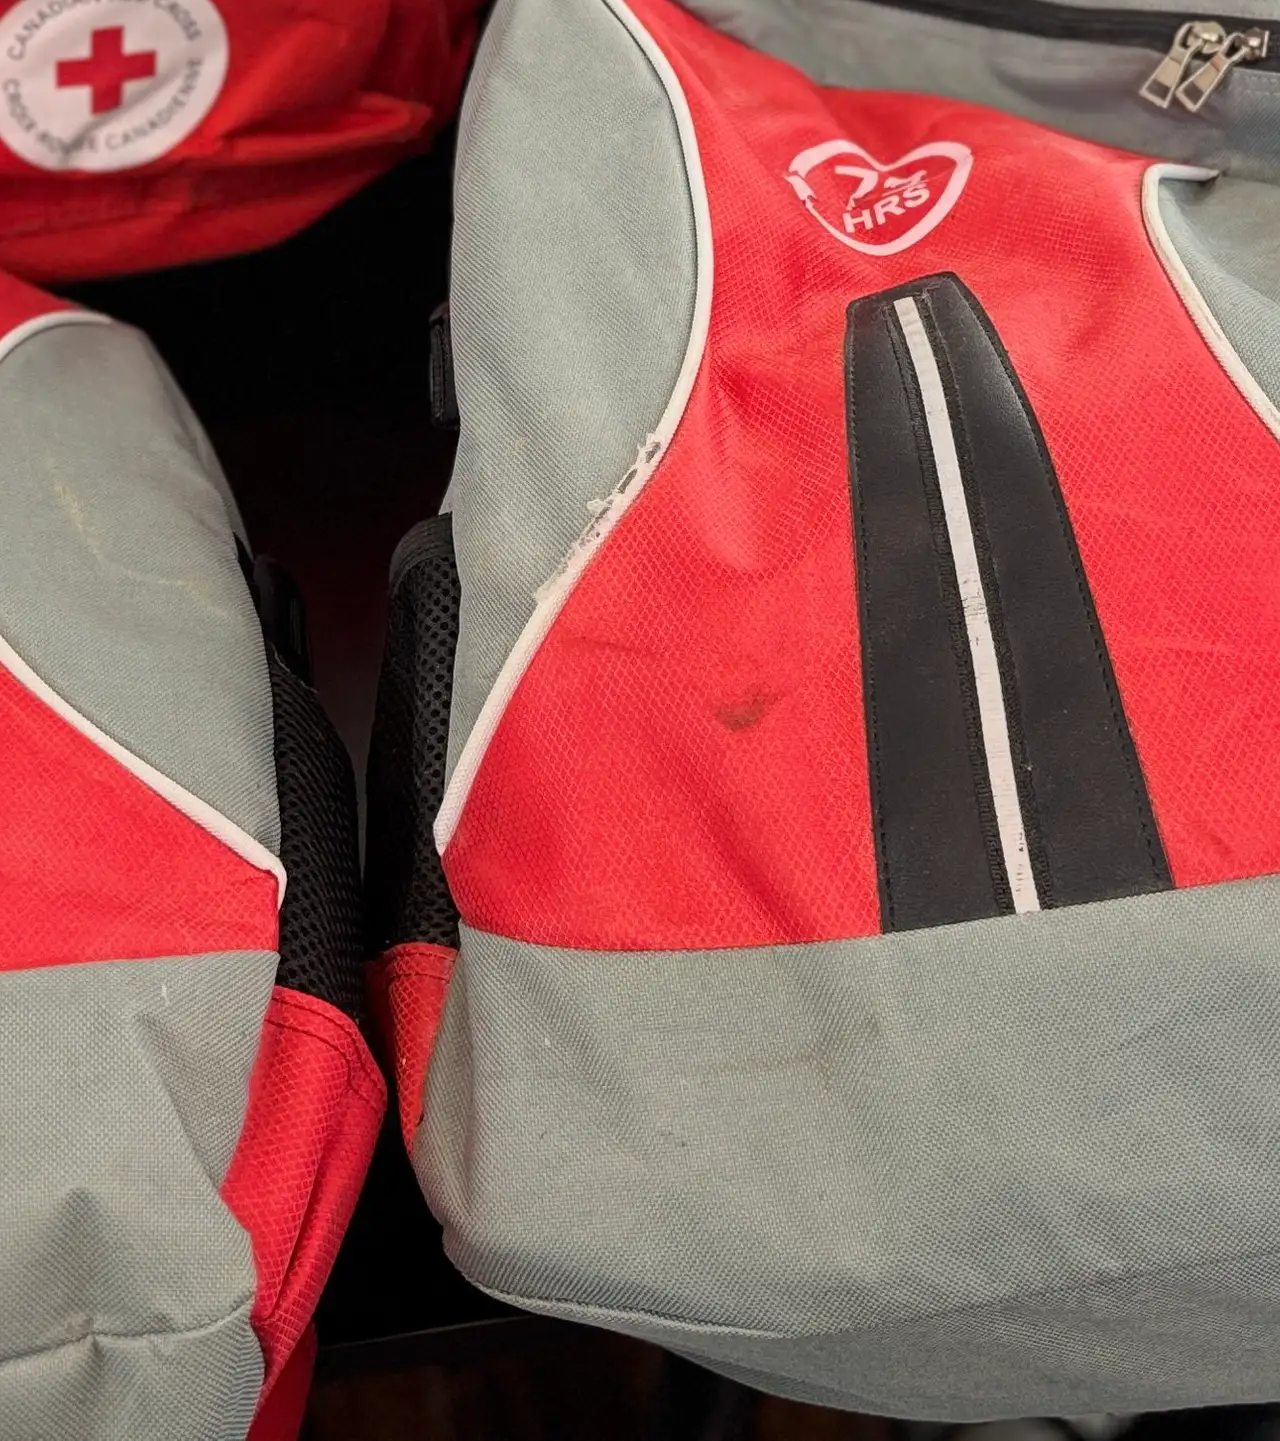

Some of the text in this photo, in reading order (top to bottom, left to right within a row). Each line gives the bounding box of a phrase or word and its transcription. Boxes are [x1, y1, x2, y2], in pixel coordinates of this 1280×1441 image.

[1, 77, 38, 134] CROIX
[105, 58, 204, 151] CANADIENNE
[842, 182, 930, 234] HRS
